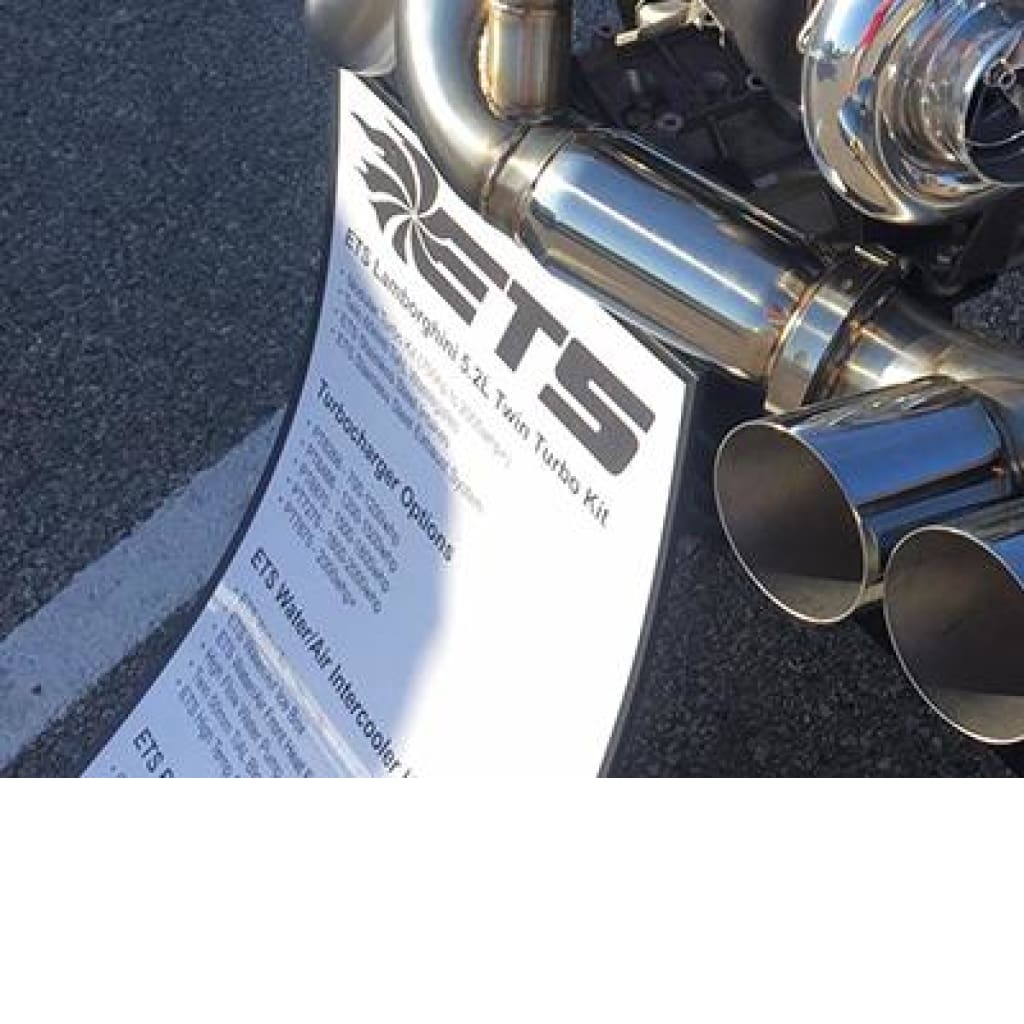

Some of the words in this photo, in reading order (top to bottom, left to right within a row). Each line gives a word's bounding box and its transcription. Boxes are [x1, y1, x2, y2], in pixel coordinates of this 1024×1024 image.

[344, 226, 370, 267] ETS
[373, 257, 459, 362] Lamborghini
[460, 352, 489, 400] 5.2L
[496, 388, 531, 441] Twin
[534, 431, 580, 495] Turbo
[583, 487, 610, 527] Kit
[408, 207, 656, 476] ETS
[317, 377, 399, 490] Turbocharger
[401, 485, 454, 562] Options
[132, 726, 165, 774] ETS
[250, 546, 280, 590] ETS
[276, 581, 332, 669] Water/Air
[328, 663, 401, 773] Intercooler
